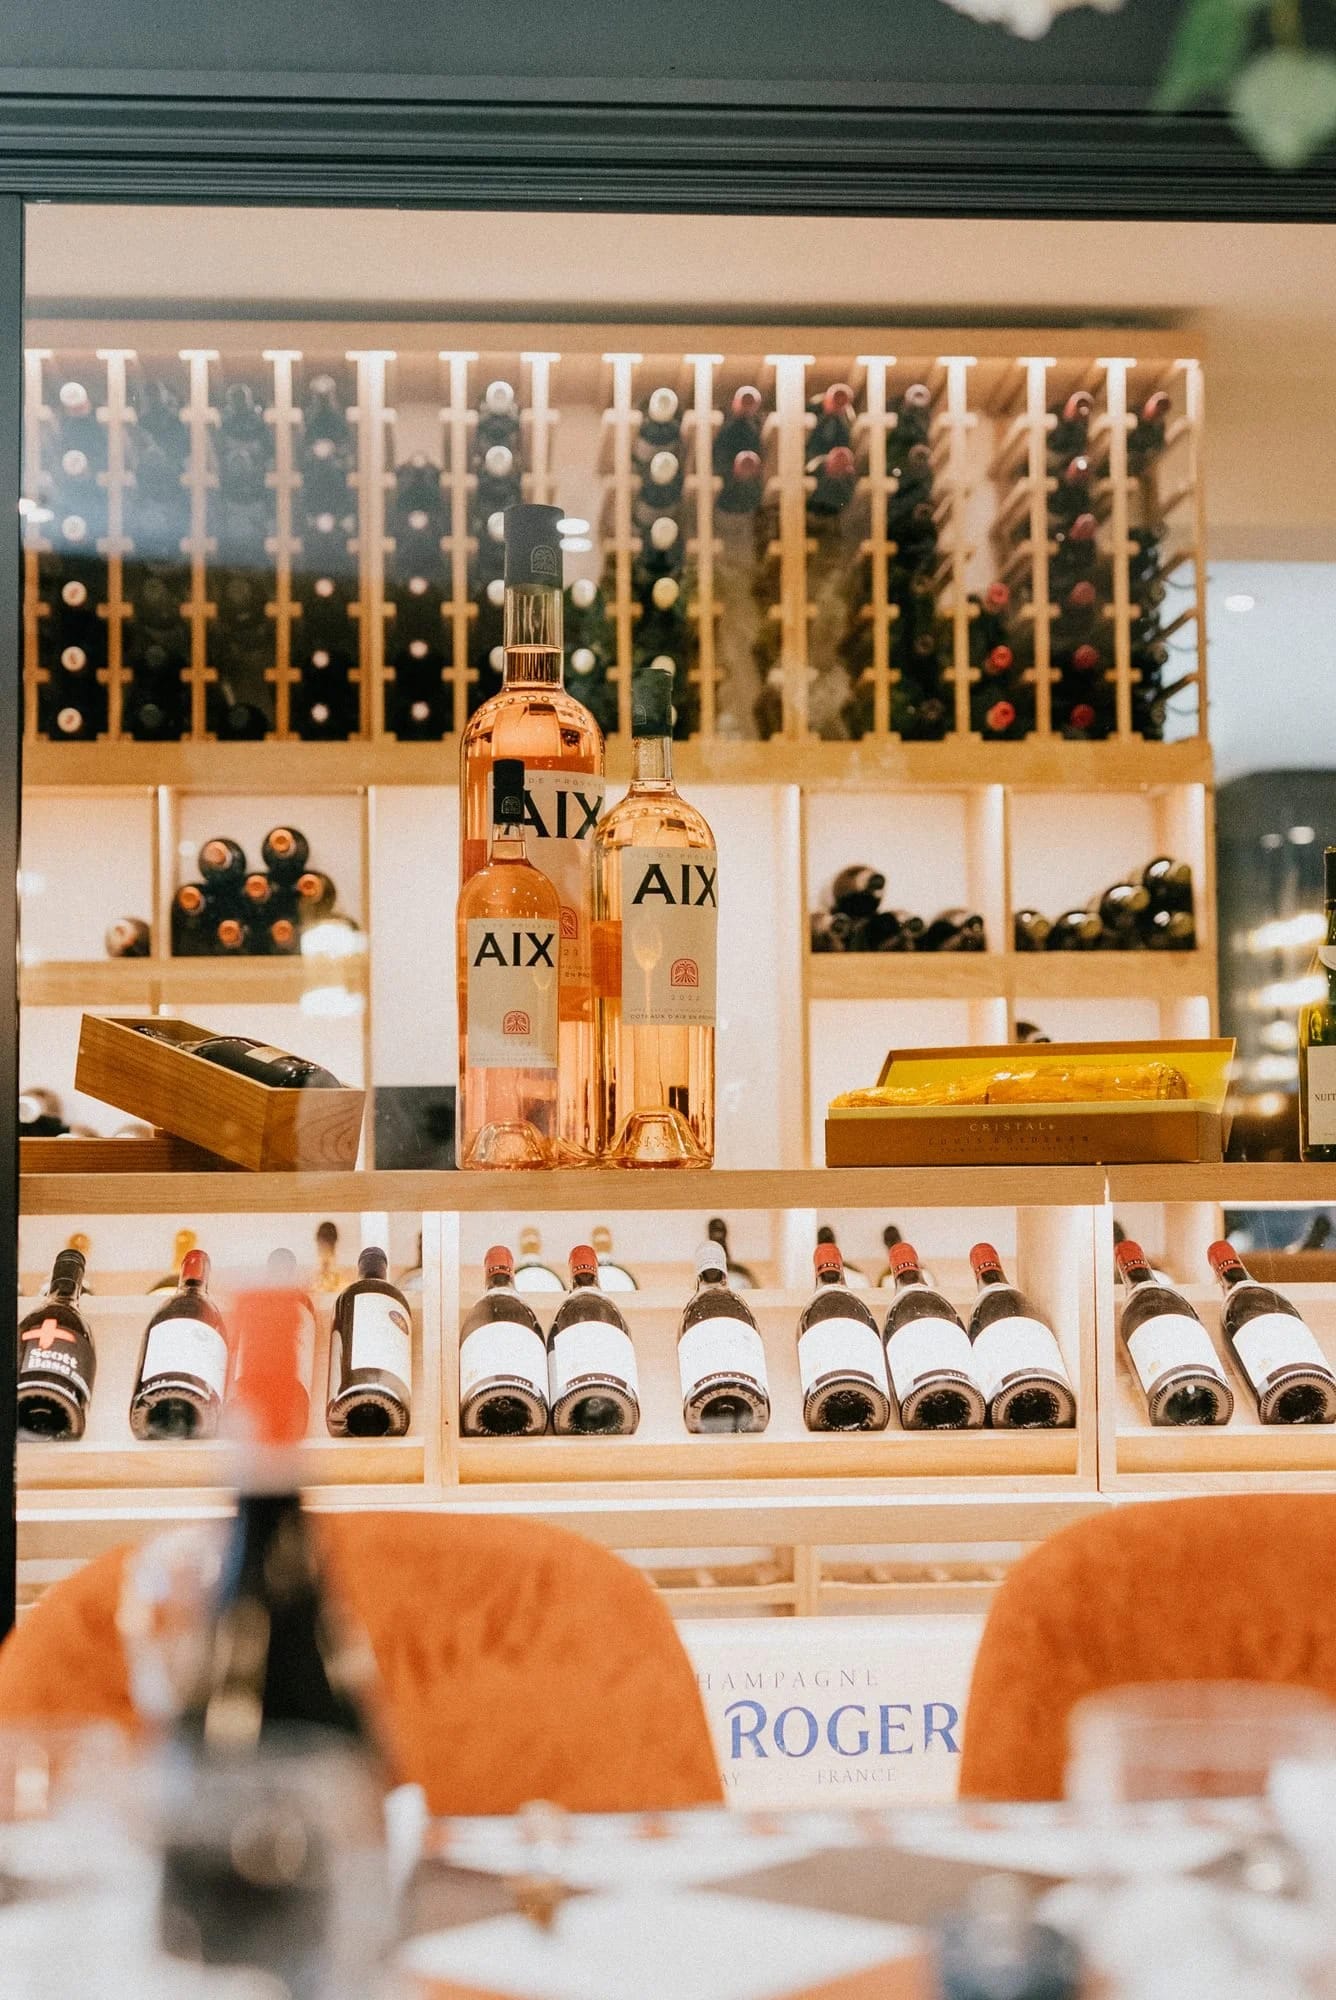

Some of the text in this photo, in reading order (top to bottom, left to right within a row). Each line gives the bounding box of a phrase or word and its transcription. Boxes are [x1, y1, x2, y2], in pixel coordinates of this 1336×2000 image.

[504, 790, 603, 839] AIX
[631, 863, 718, 908] AIX
[473, 932, 555, 968] AIX
[969, 1122, 1046, 1132] CRISTAL
[29, 1347, 79, 1369] Scott
[697, 1669, 880, 1690] HAMPAGNE
[724, 1699, 962, 1760] ROGER
[817, 1767, 897, 1785] FRANCE
